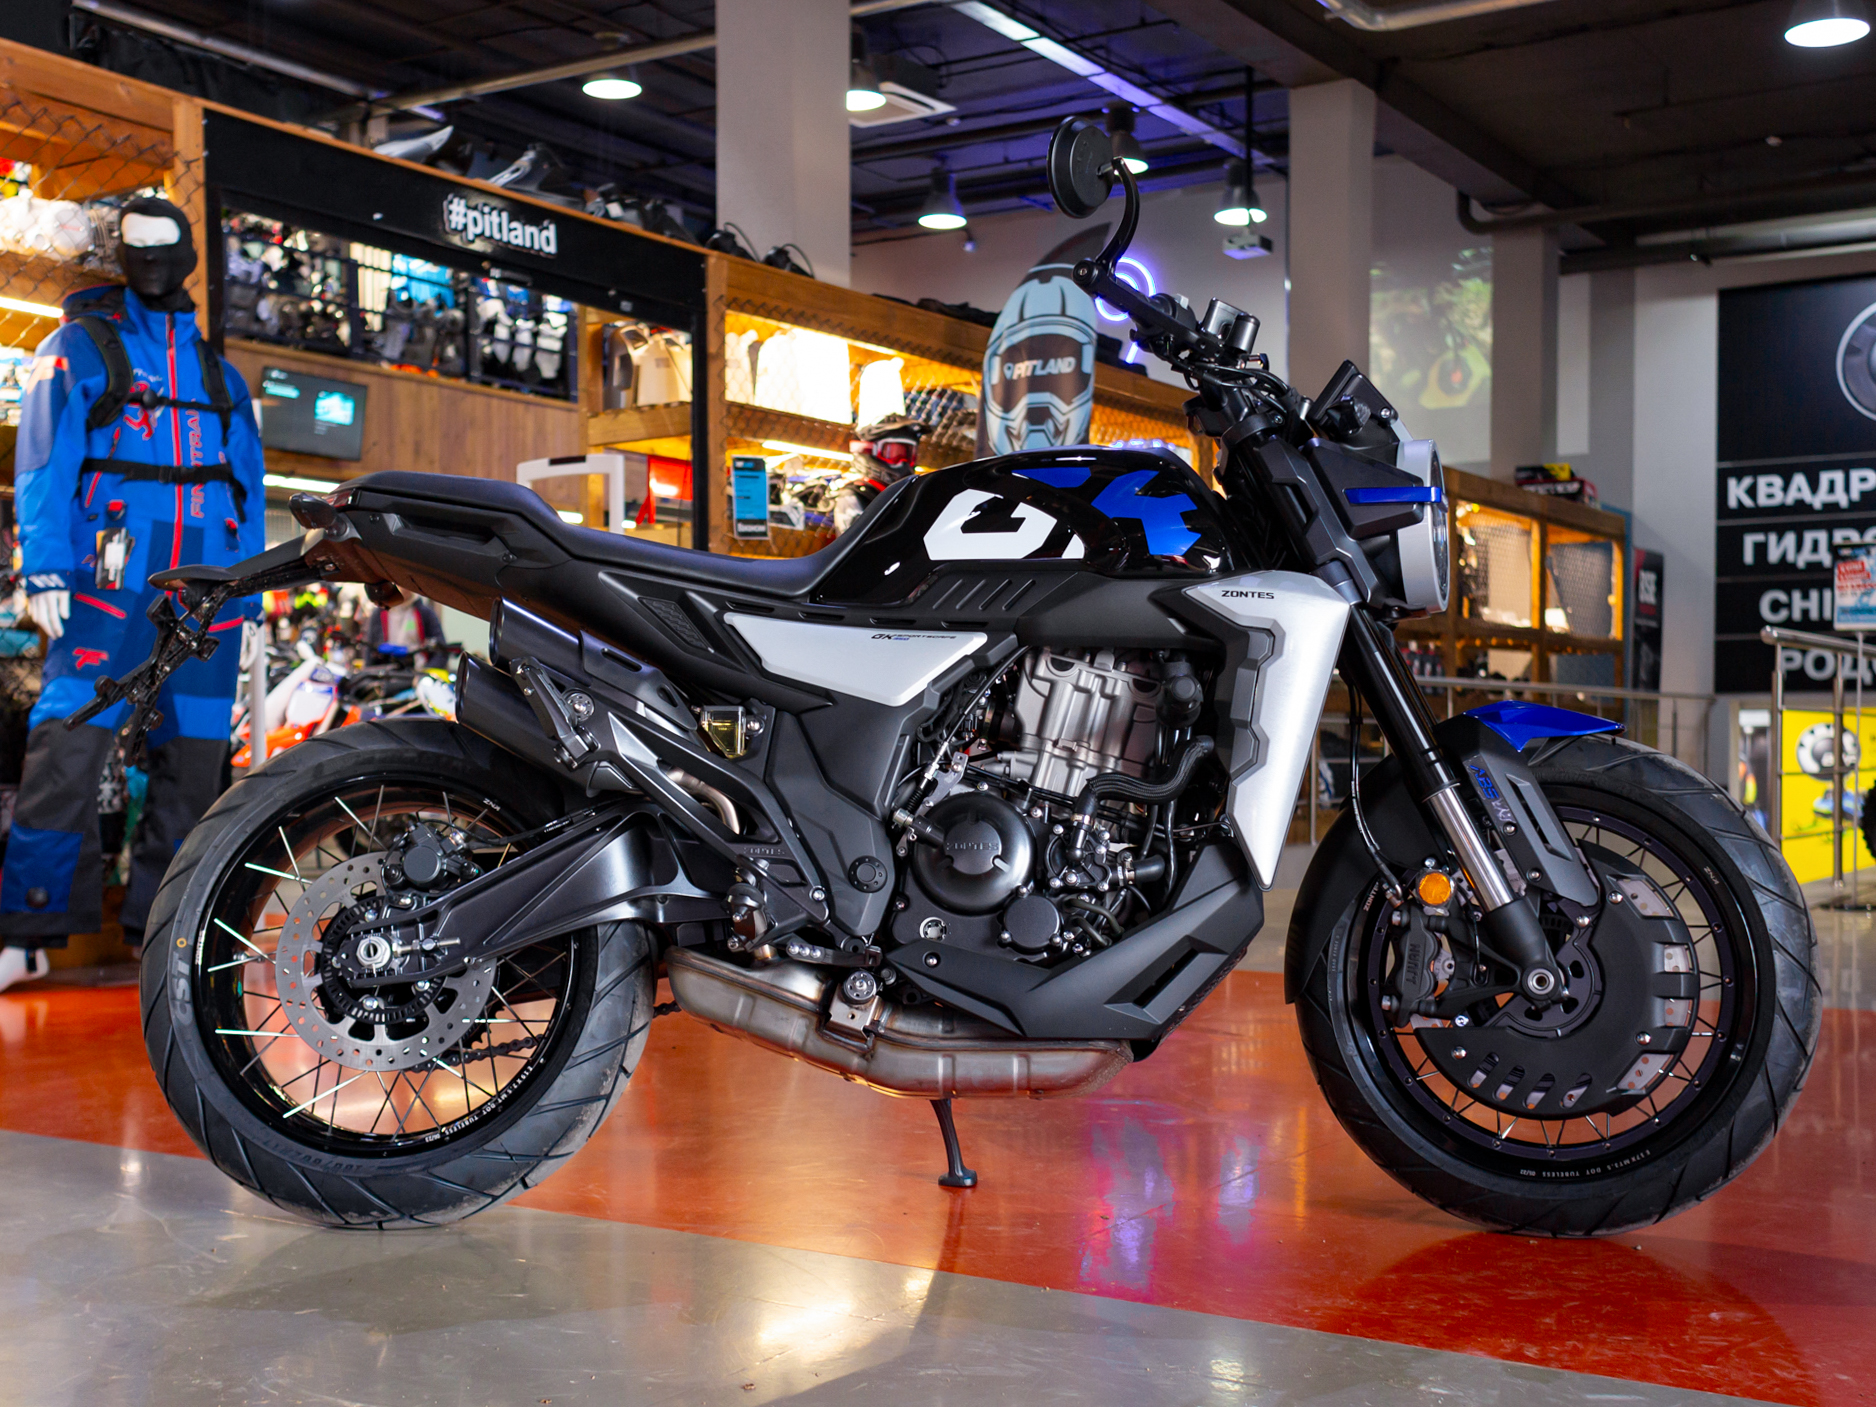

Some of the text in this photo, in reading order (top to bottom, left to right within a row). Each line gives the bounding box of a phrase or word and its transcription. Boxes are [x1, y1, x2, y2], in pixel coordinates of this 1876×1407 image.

[448, 197, 558, 255] #pitland
[1012, 357, 1076, 380] PITLAND
[1221, 589, 1275, 600] ZONTES
[1469, 764, 1500, 799] ABS
[171, 951, 193, 1025] CST
[1586, 1167, 1601, 1176] DOT
